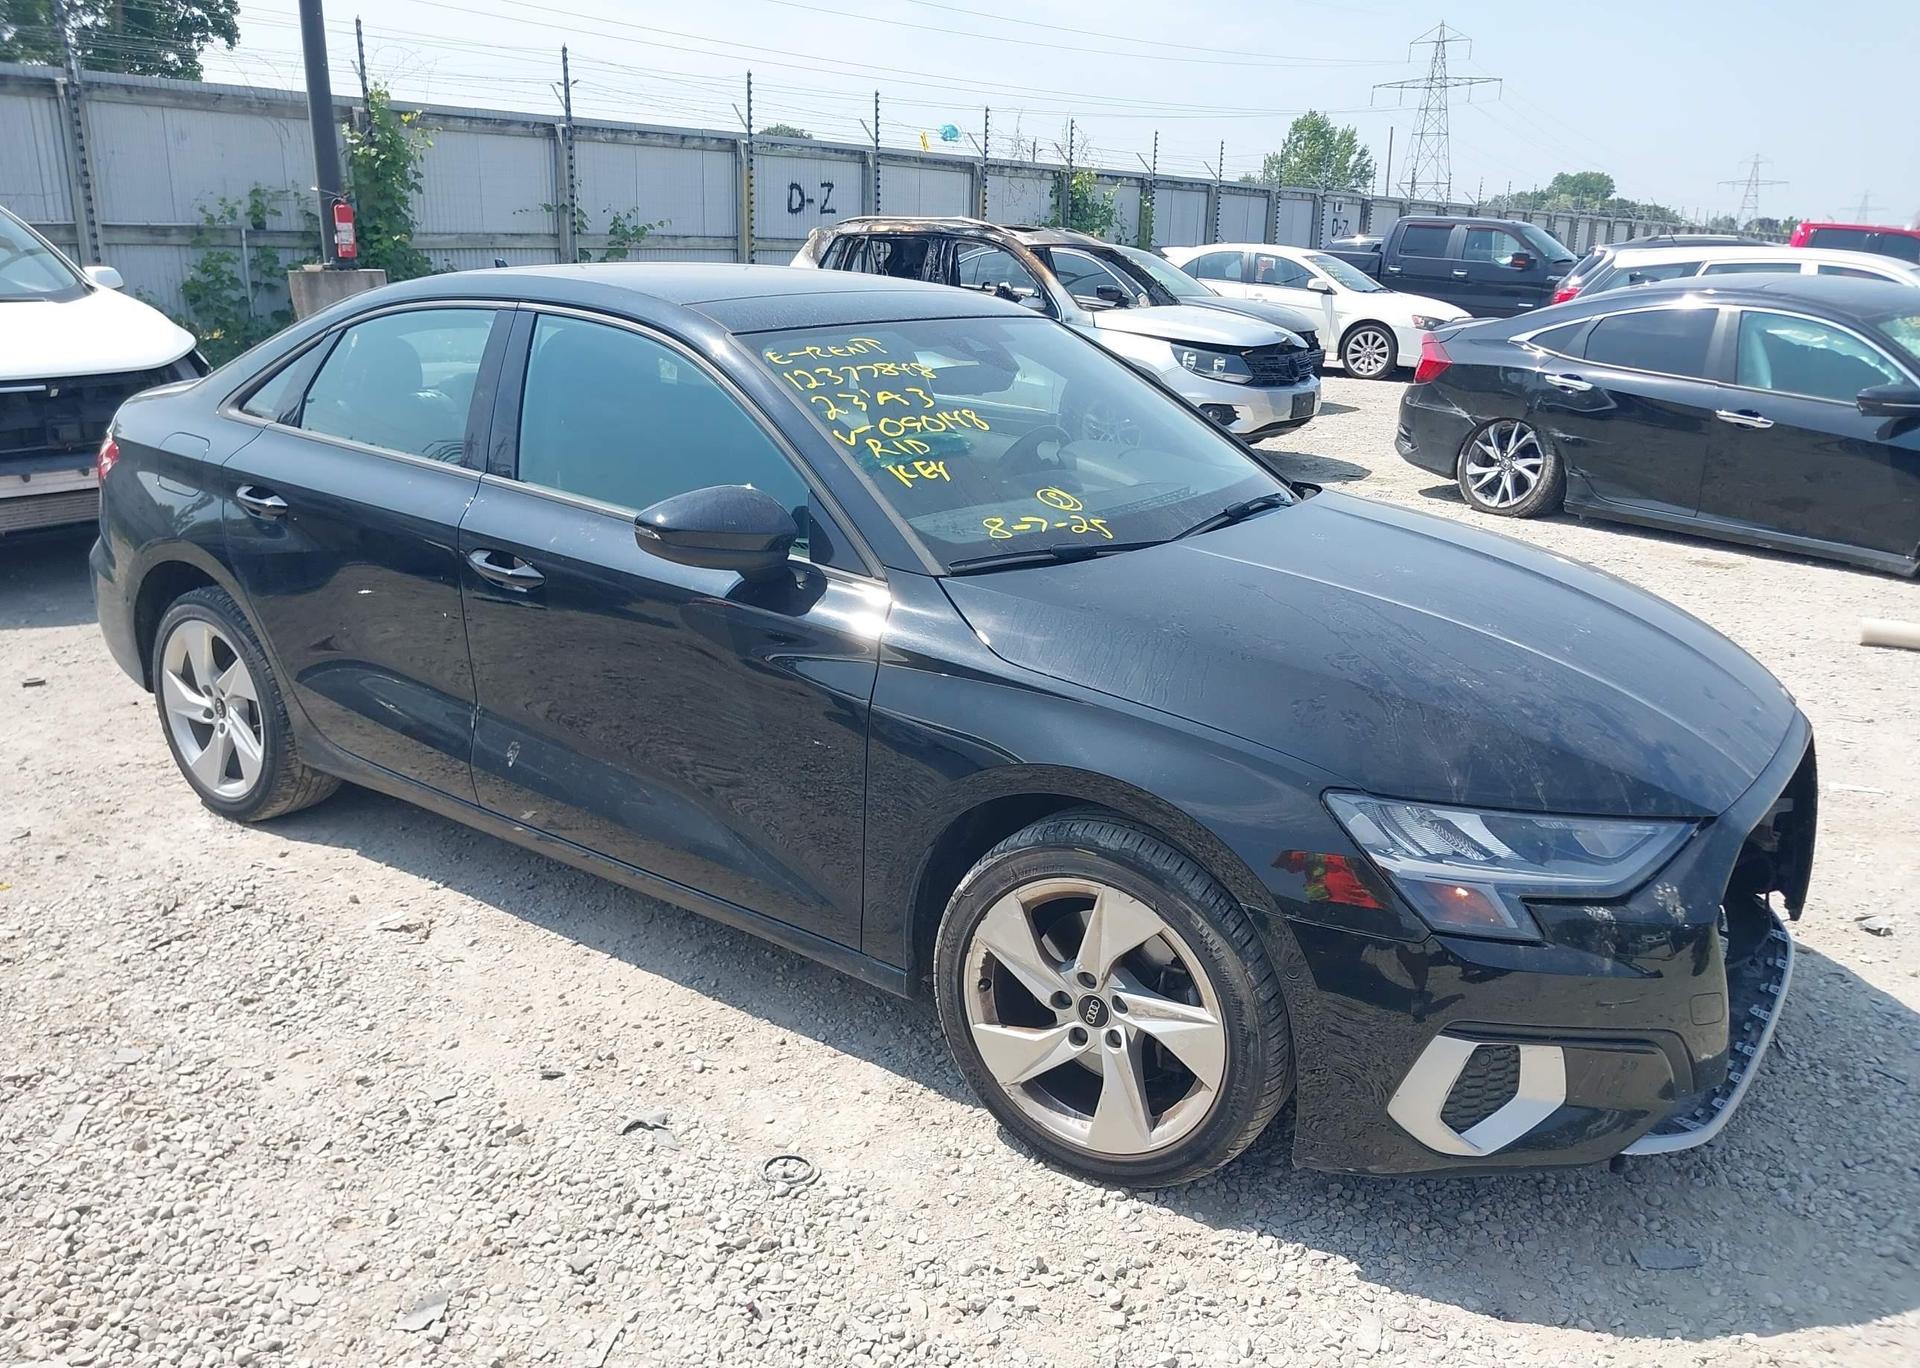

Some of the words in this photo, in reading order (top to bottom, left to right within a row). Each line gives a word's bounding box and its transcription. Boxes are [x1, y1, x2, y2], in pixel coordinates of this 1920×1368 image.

[788, 182, 836, 214] D-Z
[886, 461, 951, 488] KEY
[983, 515, 1113, 539] 8-7-25
